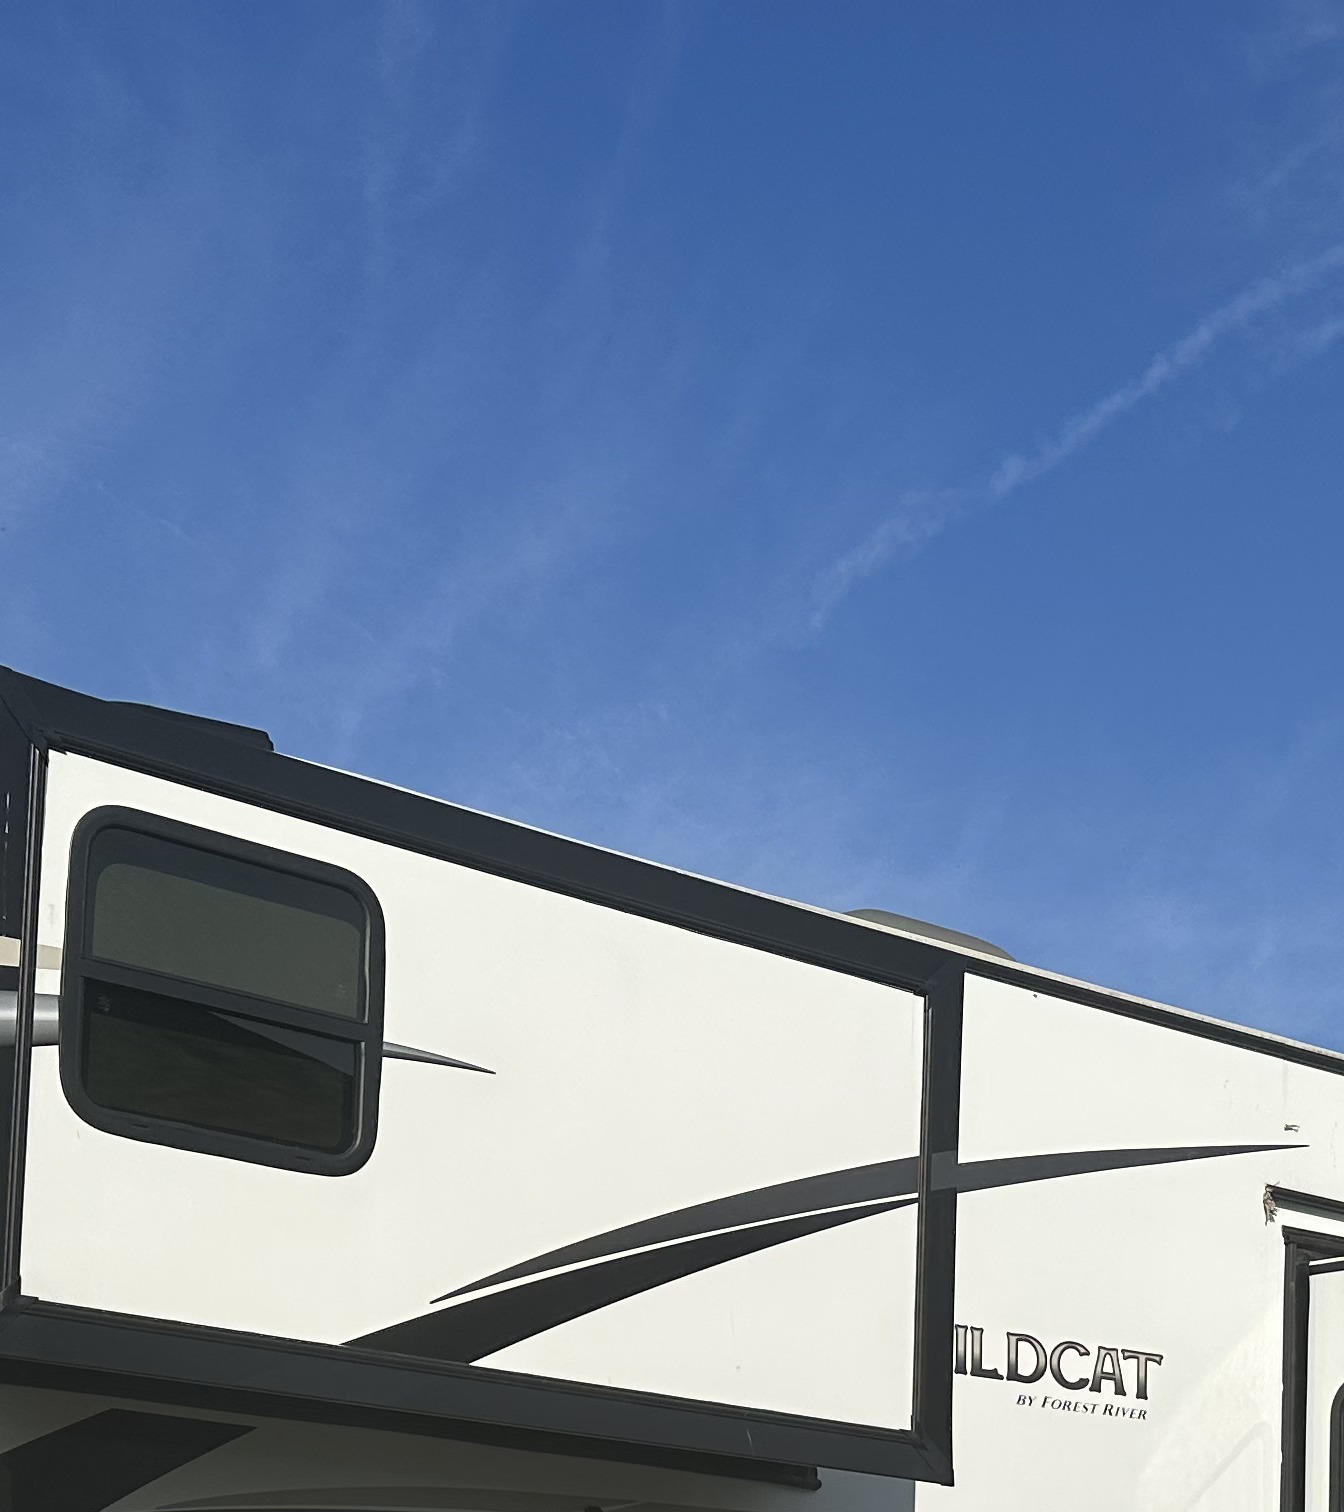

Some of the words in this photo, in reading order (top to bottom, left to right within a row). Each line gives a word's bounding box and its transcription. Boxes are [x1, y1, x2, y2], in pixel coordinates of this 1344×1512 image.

[954, 1324, 1164, 1400] ILDCAT
[1016, 1394, 1037, 1407] BY
[1041, 1395, 1099, 1415] FOREST
[1102, 1403, 1148, 1420] RIVER
